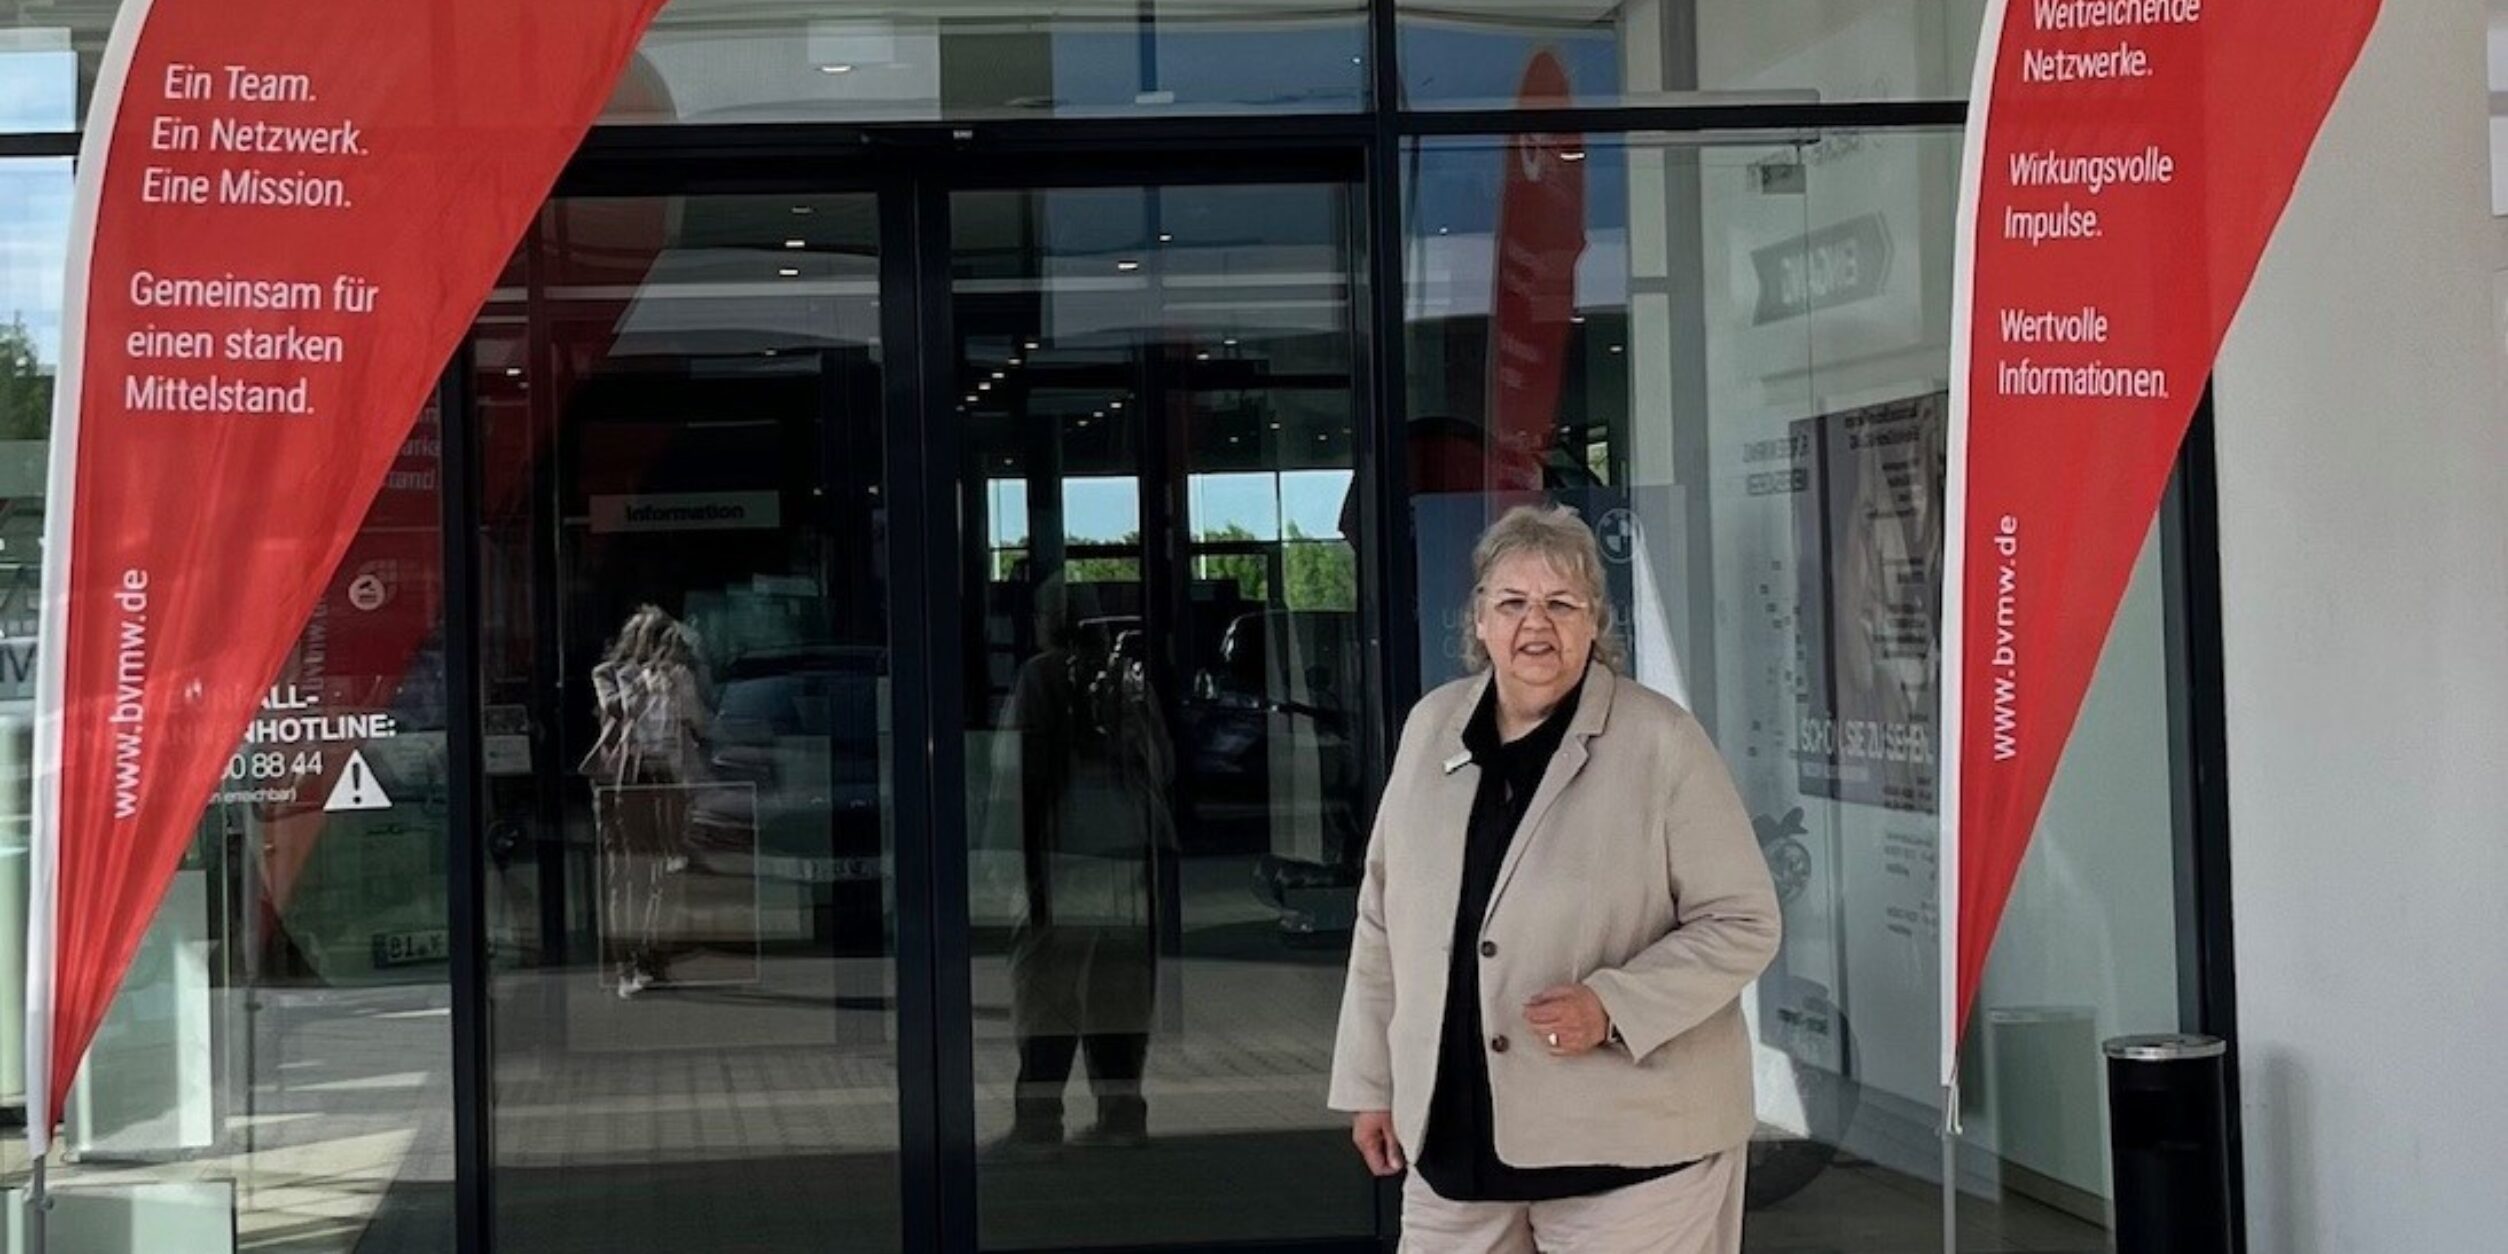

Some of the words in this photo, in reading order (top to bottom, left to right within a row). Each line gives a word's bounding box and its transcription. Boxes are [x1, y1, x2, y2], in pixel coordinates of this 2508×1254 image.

[2035, 0, 2201, 30] Weitreichende
[2024, 44, 2153, 82] Netzwerke.
[164, 65, 211, 100] Ein
[226, 66, 316, 103] Team.
[151, 116, 198, 150] Ein
[210, 118, 370, 156] Netzwerk.
[142, 168, 209, 203] Eine
[219, 169, 352, 208] Mission.
[2009, 146, 2174, 194] Wirkungsvolle
[2005, 199, 2103, 246] Impulse.
[131, 271, 321, 310] Gemeinsam
[333, 276, 379, 313] für
[2001, 307, 2108, 342] Wertvolle
[127, 327, 214, 358] einen
[225, 328, 343, 363] starken
[125, 375, 315, 414] Mittelstand.
[1998, 359, 2169, 398] Informationen.
[625, 501, 746, 523] Information
[1992, 514, 2017, 760] www.bvmw.de
[108, 568, 149, 819] www.bvmw.de
[250, 751, 286, 779] 88
[290, 750, 323, 776] 44
